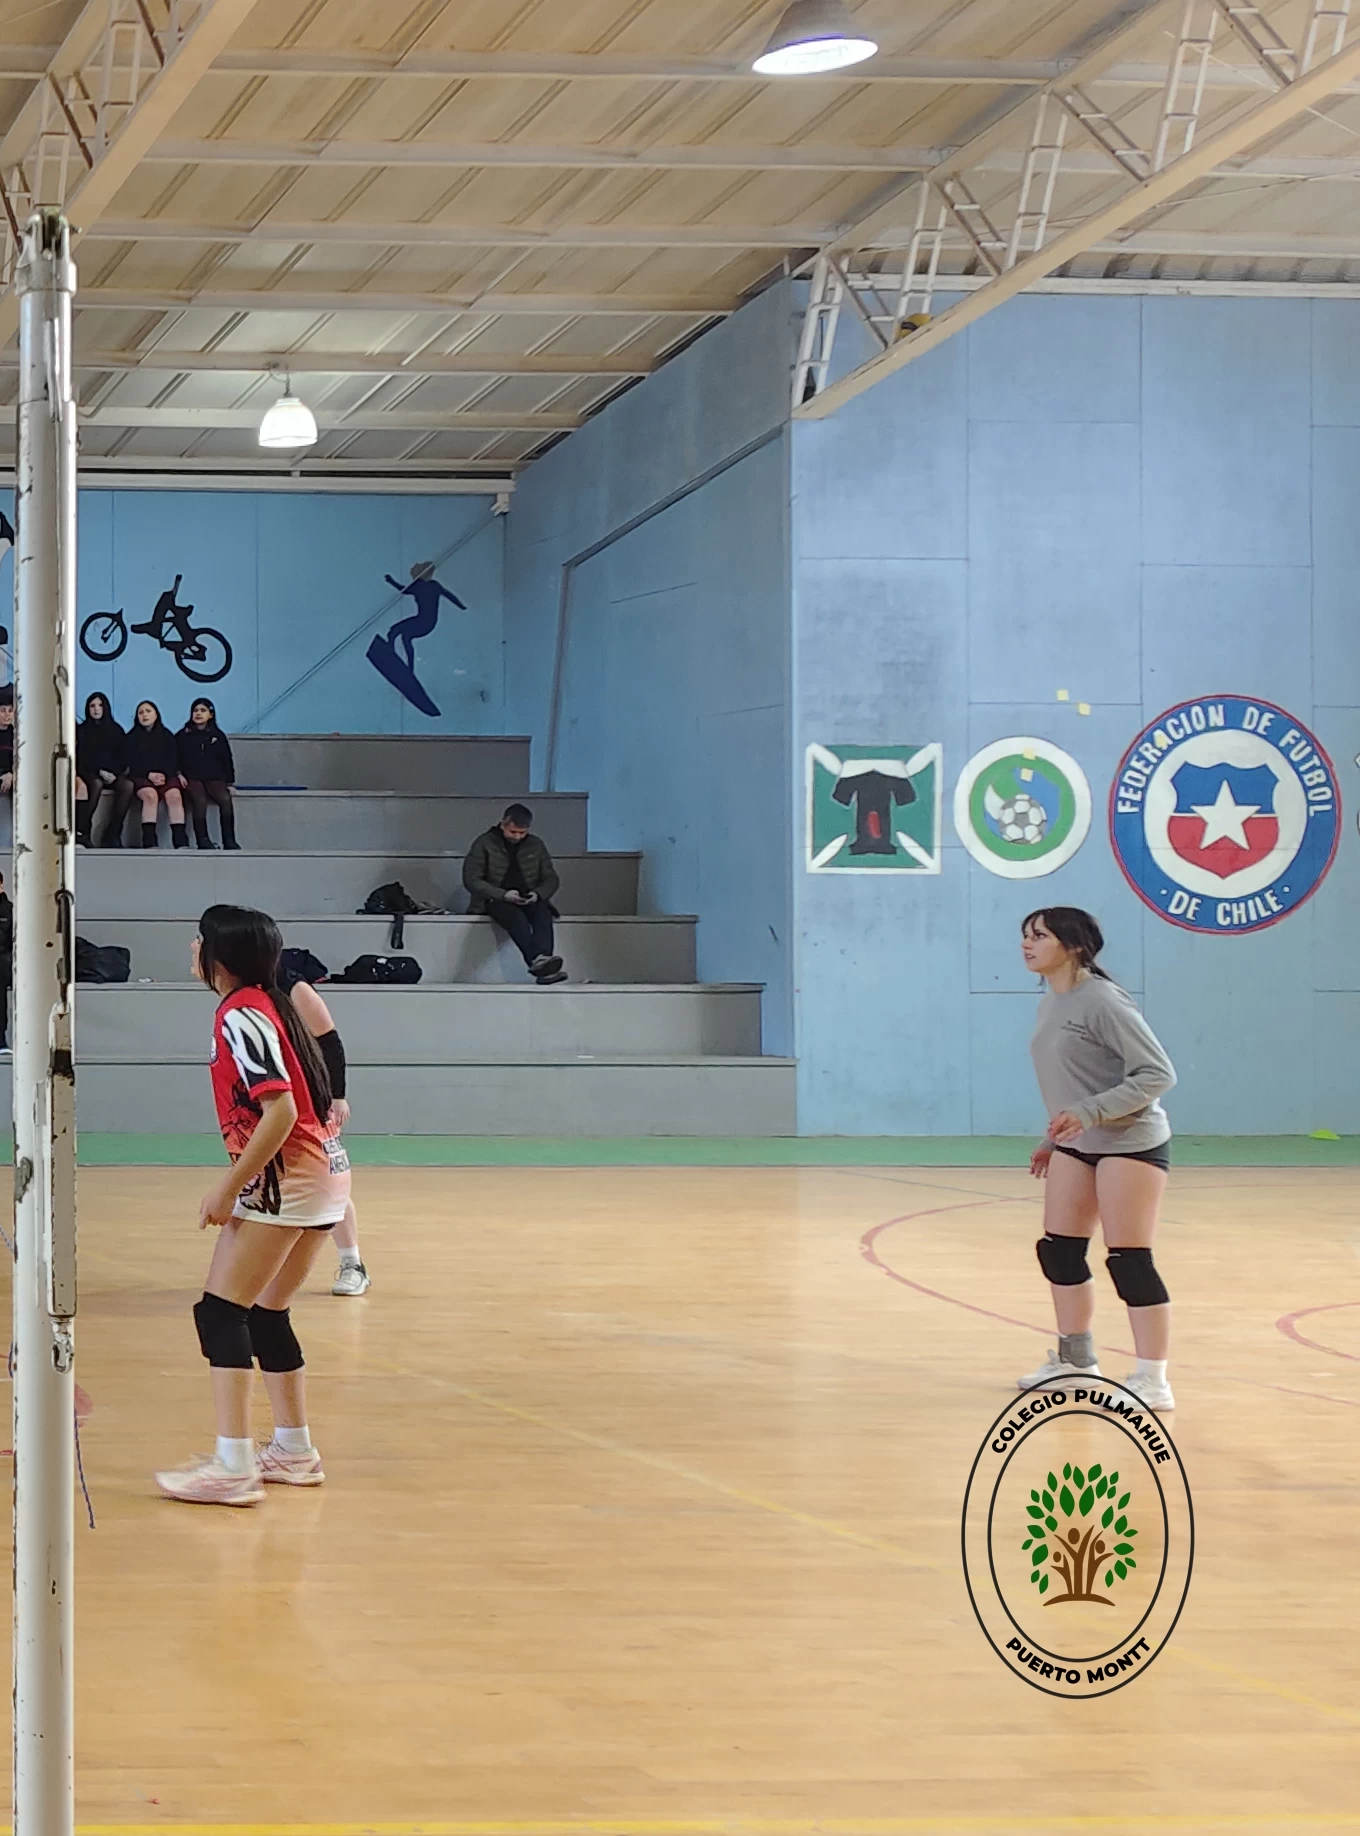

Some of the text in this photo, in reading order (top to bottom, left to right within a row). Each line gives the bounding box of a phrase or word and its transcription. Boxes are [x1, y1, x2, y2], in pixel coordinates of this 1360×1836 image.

[1242, 706, 1275, 735] DE
[1279, 729, 1333, 817] FUTBOL
[1168, 889, 1284, 926] DE CHILE
